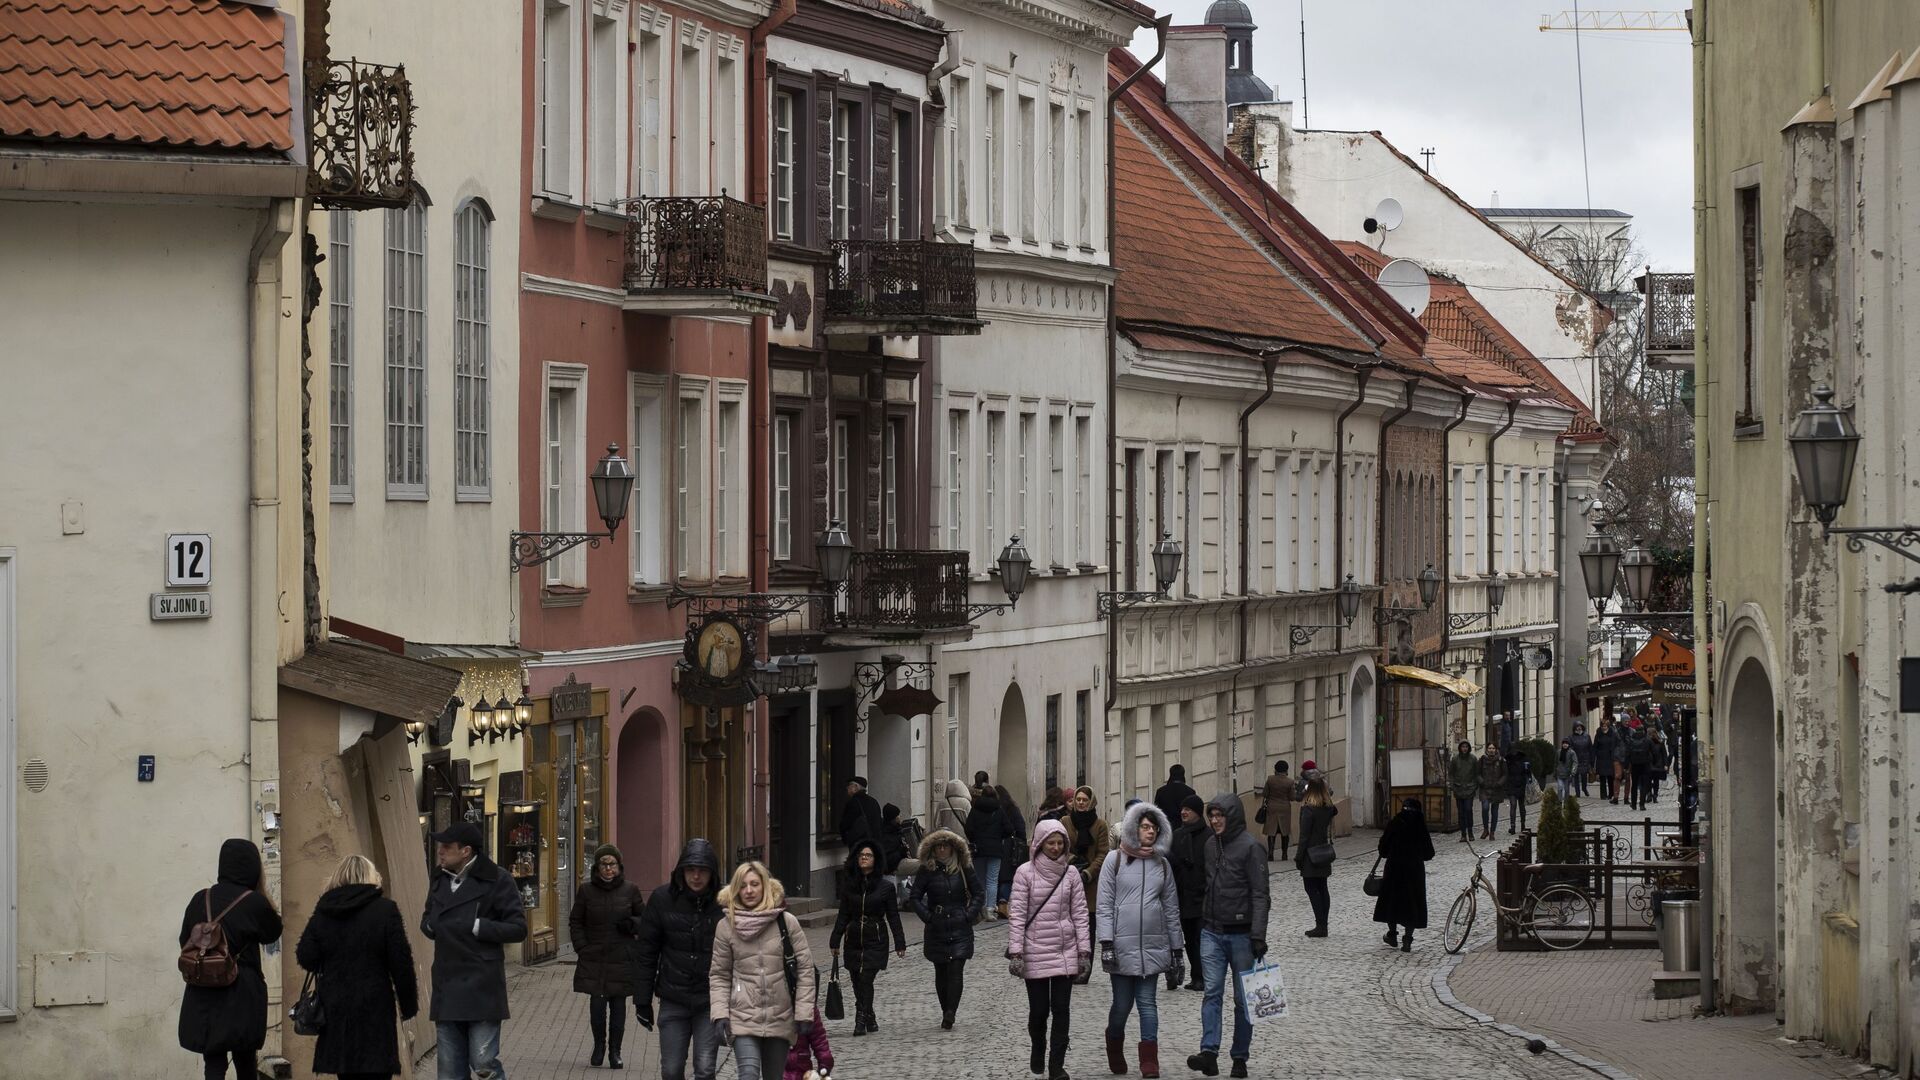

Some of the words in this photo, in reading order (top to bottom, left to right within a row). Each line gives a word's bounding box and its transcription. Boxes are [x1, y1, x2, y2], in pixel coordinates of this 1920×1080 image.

[174, 541, 204, 578] 12
[199, 600, 208, 614] g.
[1641, 663, 1688, 672] CAFFEINE
